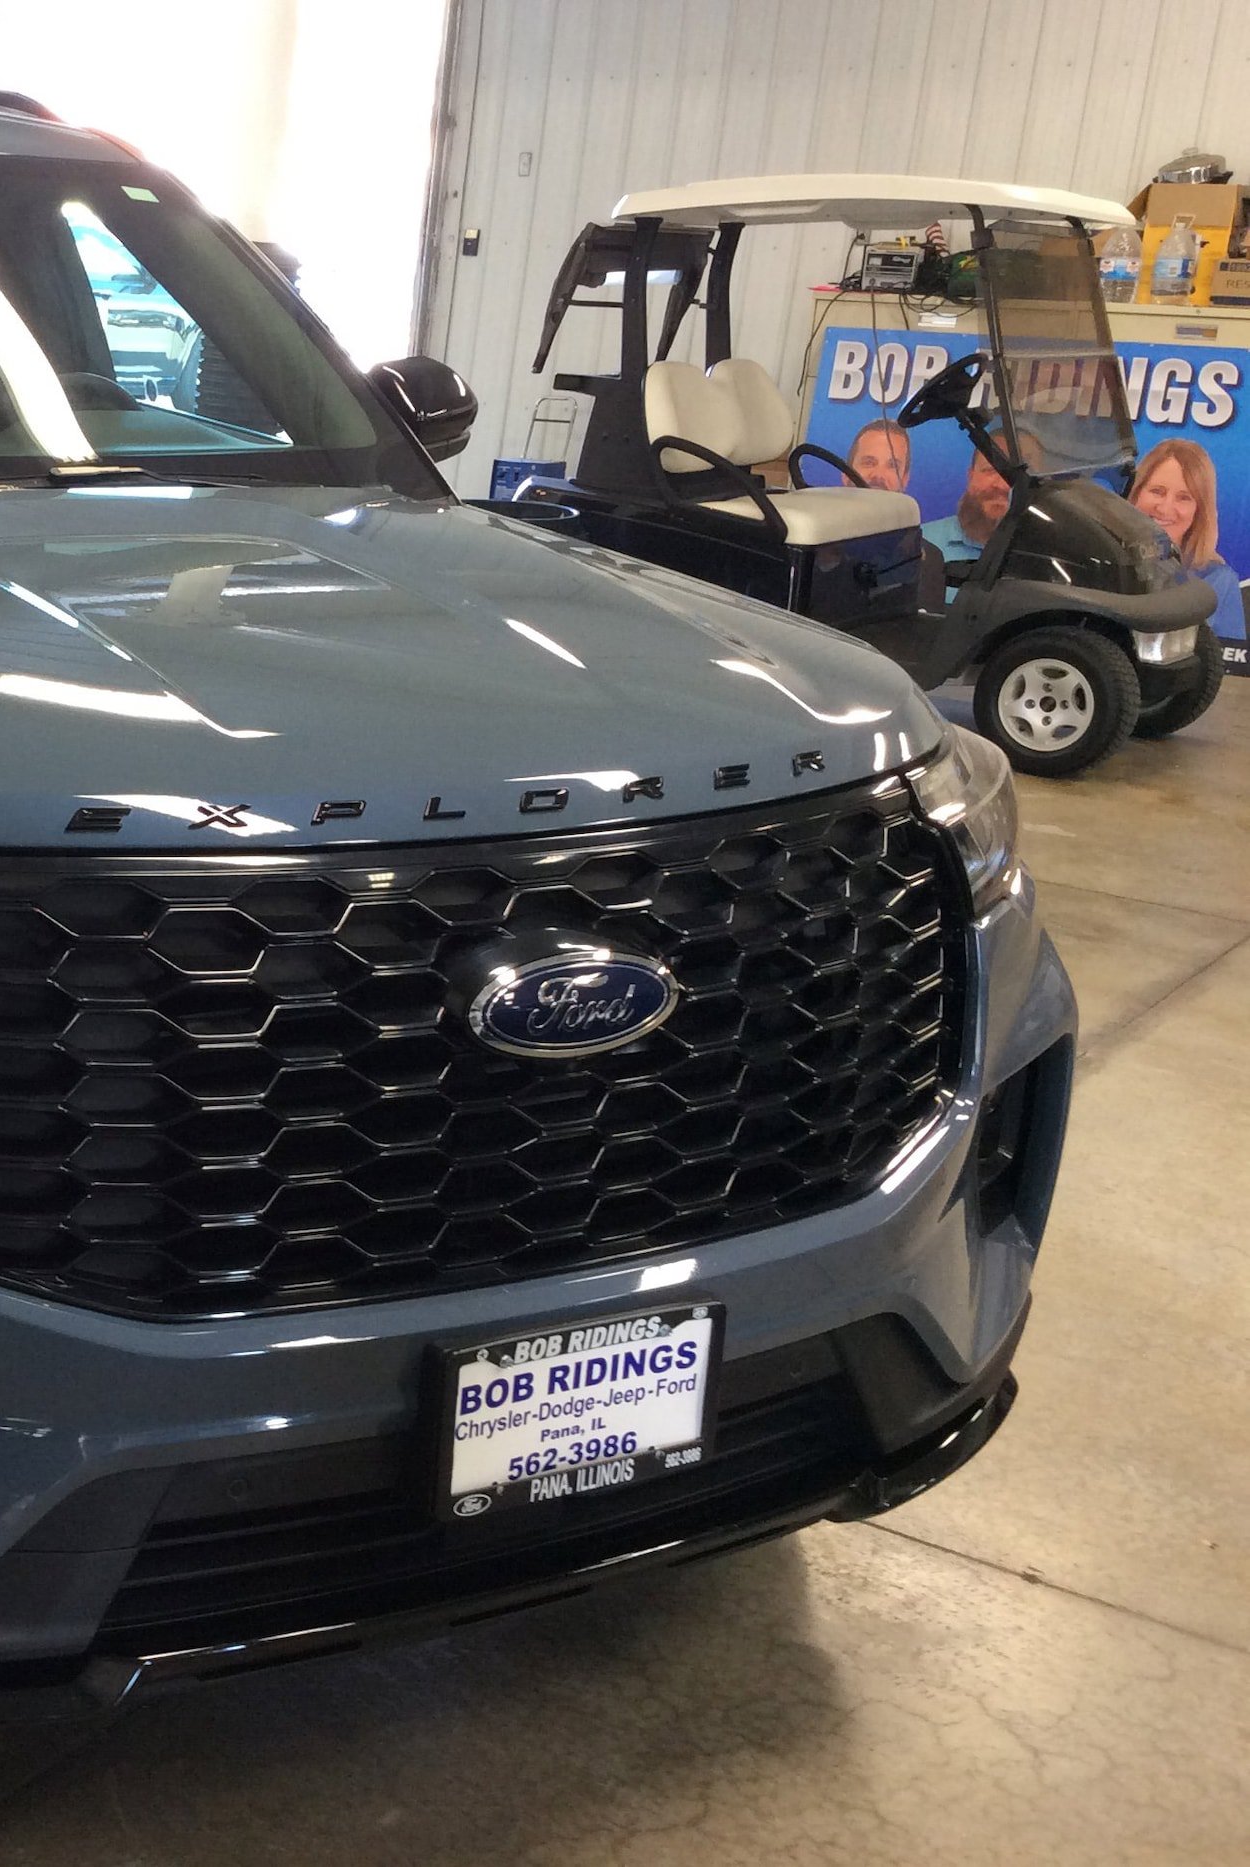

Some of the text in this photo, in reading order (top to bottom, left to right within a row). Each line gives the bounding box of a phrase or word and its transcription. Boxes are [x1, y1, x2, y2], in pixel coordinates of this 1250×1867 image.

[1221, 646, 1247, 664] EK
[65, 749, 827, 833] EXPLORER
[527, 972, 636, 1036] Ford
[513, 1315, 662, 1364] BOB RIDINGS
[460, 1340, 698, 1416] BOB RIDINGS
[454, 1373, 698, 1441] Chrysler-Dodge-Jeep-Ford
[540, 1417, 607, 1442] Pana, IL
[508, 1431, 638, 1481] 562-3986
[576, 1458, 636, 1493] ILLINOIS
